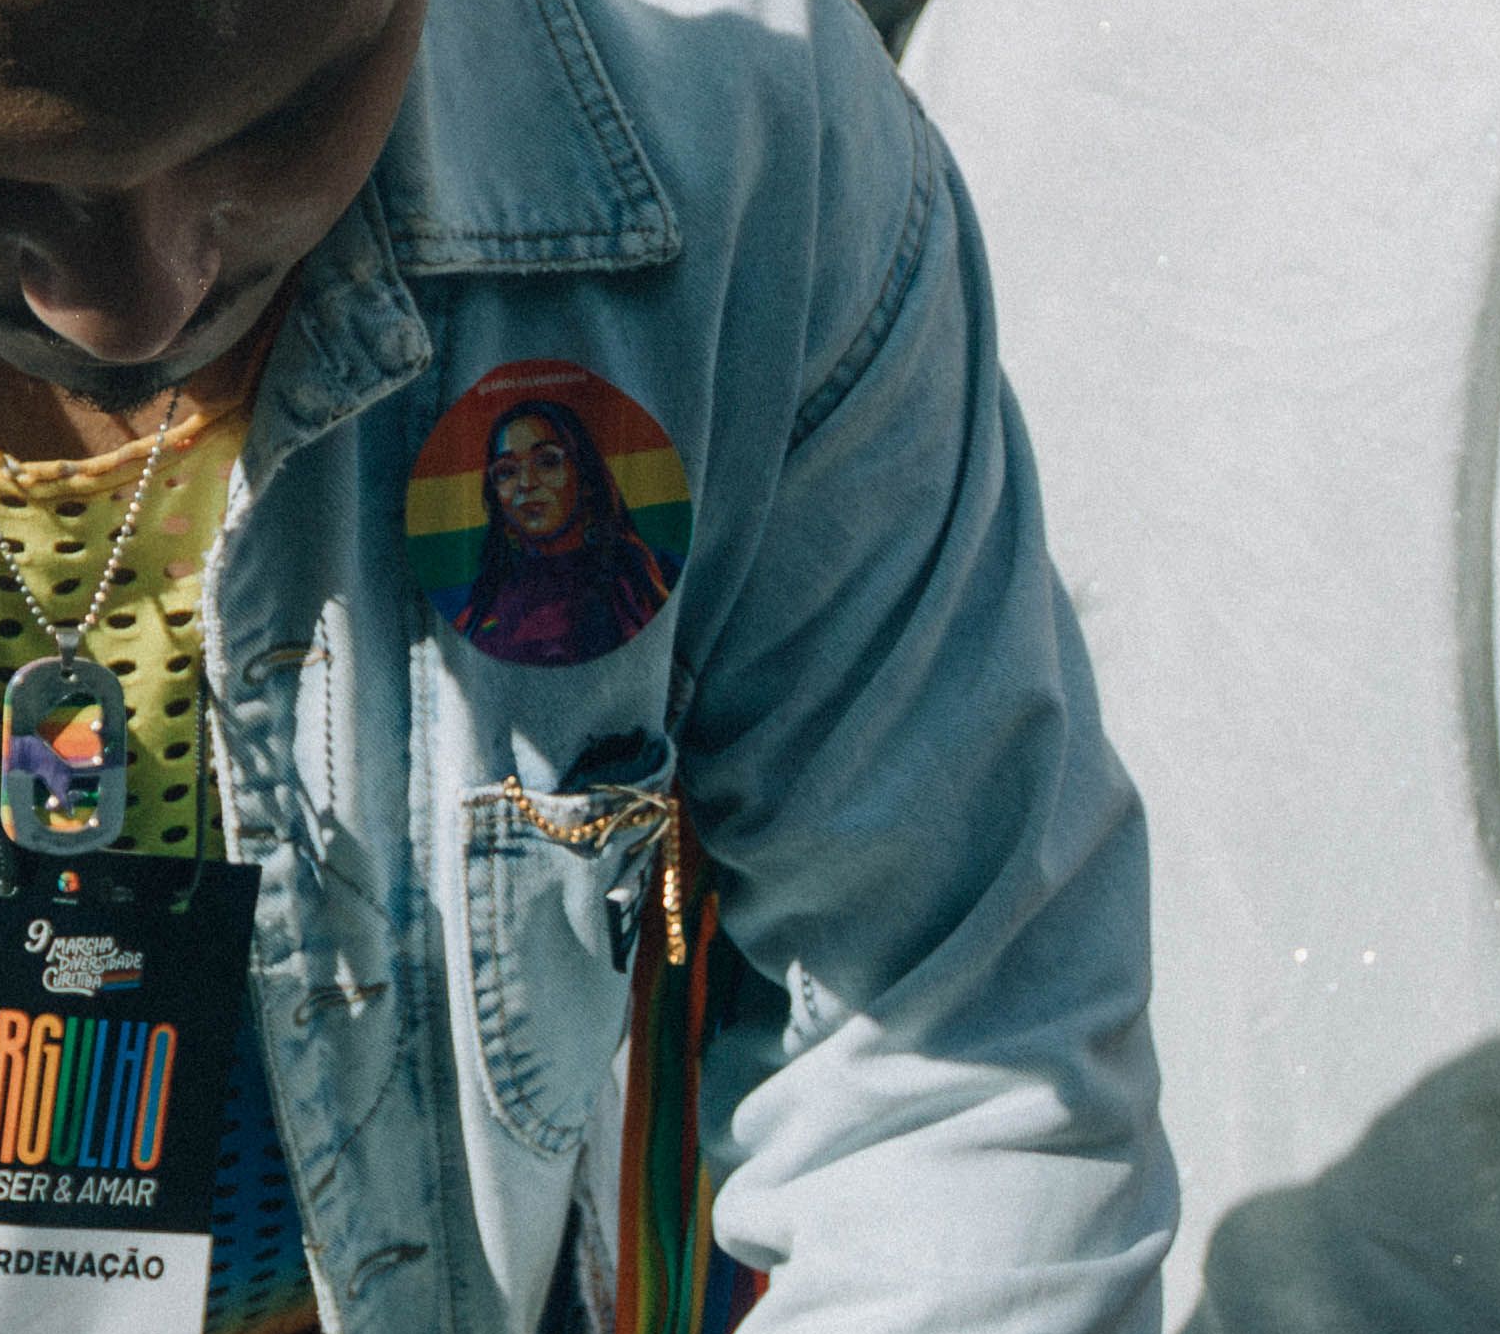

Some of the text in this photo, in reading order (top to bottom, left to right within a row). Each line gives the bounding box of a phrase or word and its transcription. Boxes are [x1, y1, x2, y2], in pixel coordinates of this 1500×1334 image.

[46, 937, 118, 963] MARCHA
[56, 951, 143, 975] DIVERSIDADE
[52, 1175, 73, 1203] &
[76, 1175, 157, 1206] AMAR
